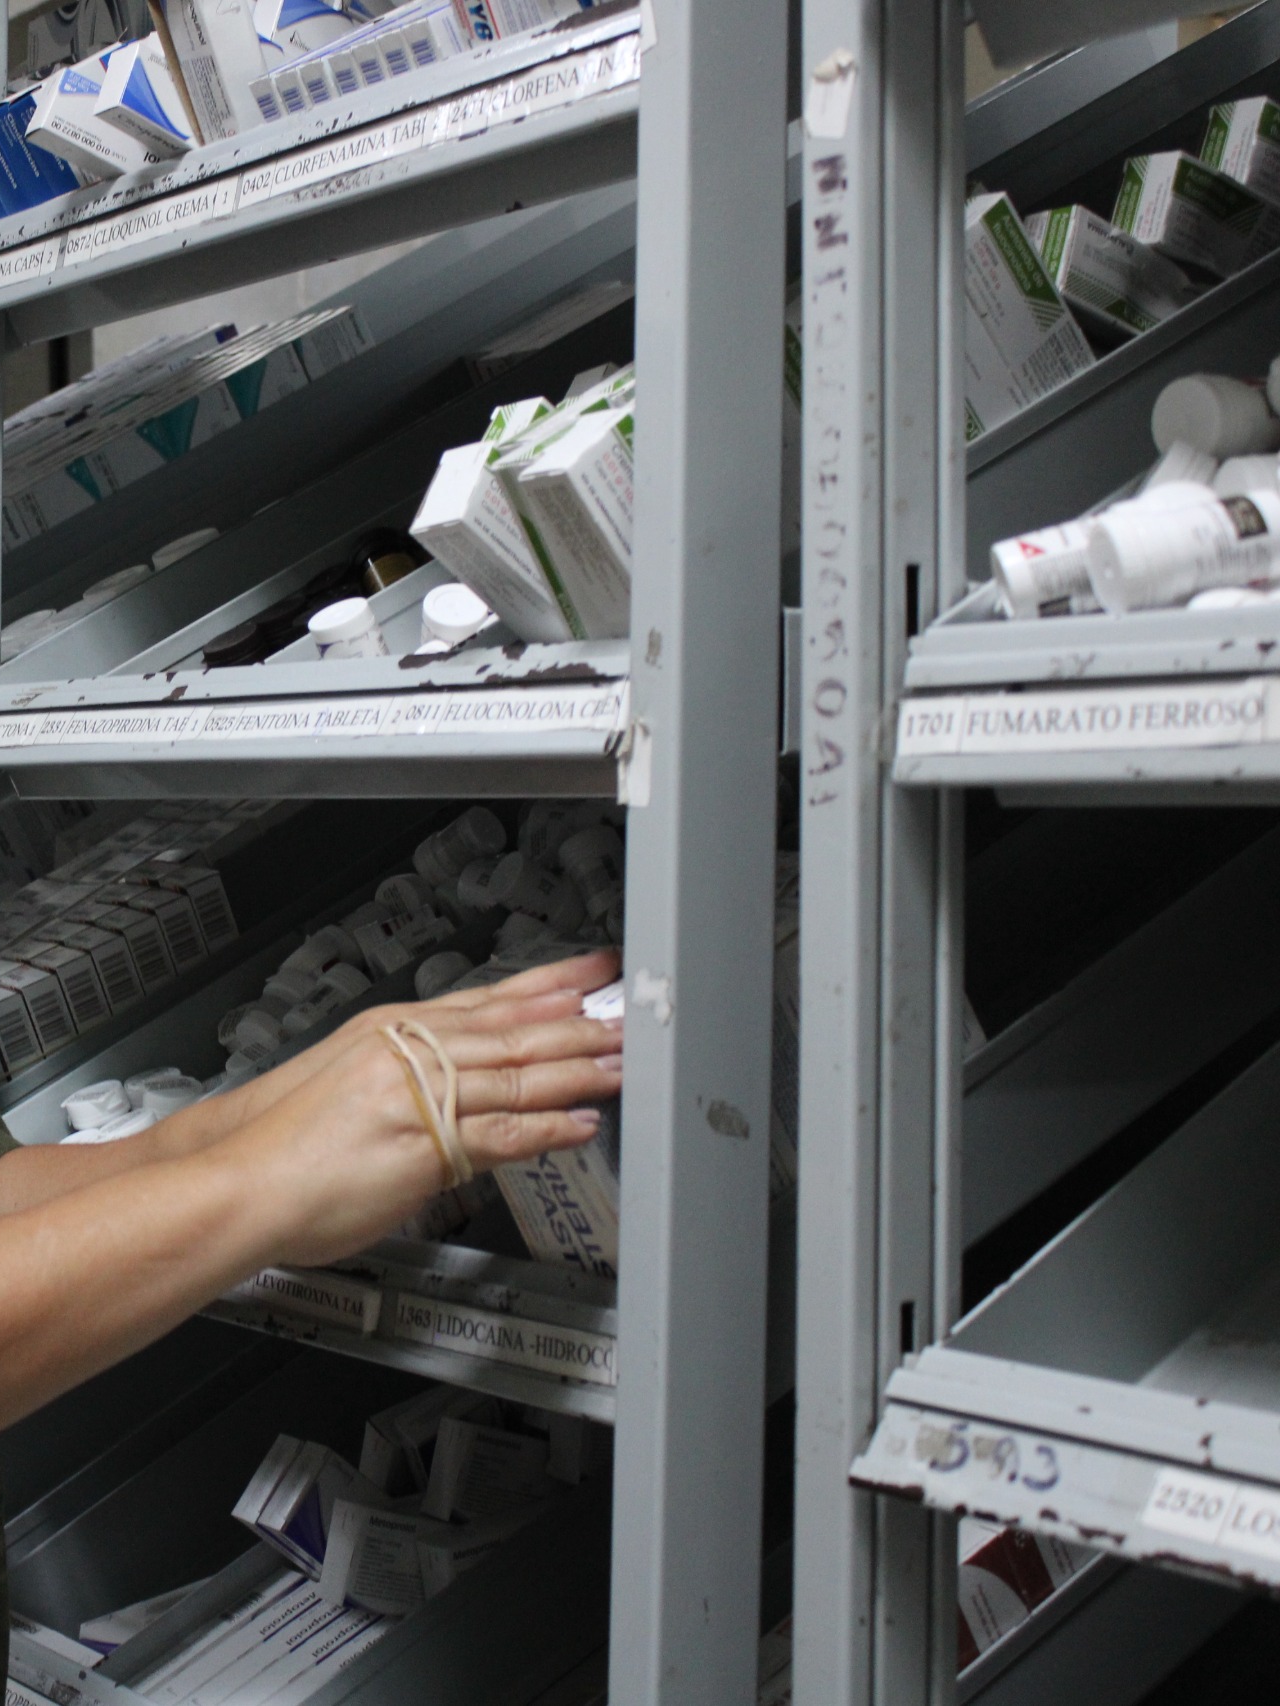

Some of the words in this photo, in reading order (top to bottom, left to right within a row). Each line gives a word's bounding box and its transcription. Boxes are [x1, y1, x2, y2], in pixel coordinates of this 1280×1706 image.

[7, 112, 40, 178] Clindamicina
[242, 171, 271, 197] 0402
[274, 131, 387, 186] CLORFENAMINA
[67, 232, 92, 255] 0872
[94, 211, 164, 247] CLIOQUINOL
[165, 194, 210, 222] CREMA
[67, 716, 163, 735] FENAZOPIRIDINA
[205, 715, 233, 731] 0525
[236, 711, 310, 731] FENITOINA
[313, 708, 382, 728] TABLETA
[392, 710, 400, 724] 2
[405, 703, 442, 721] 0811
[443, 699, 576, 722] FLUOCINOLONA
[905, 713, 955, 738] 1701
[968, 704, 1122, 737] FUMARATO
[1128, 692, 1264, 731] FERROSO
[255, 1273, 340, 1312] LEVOTIROXINA
[399, 1304, 431, 1329] 1363
[436, 1313, 525, 1353] LIDOCAINA
